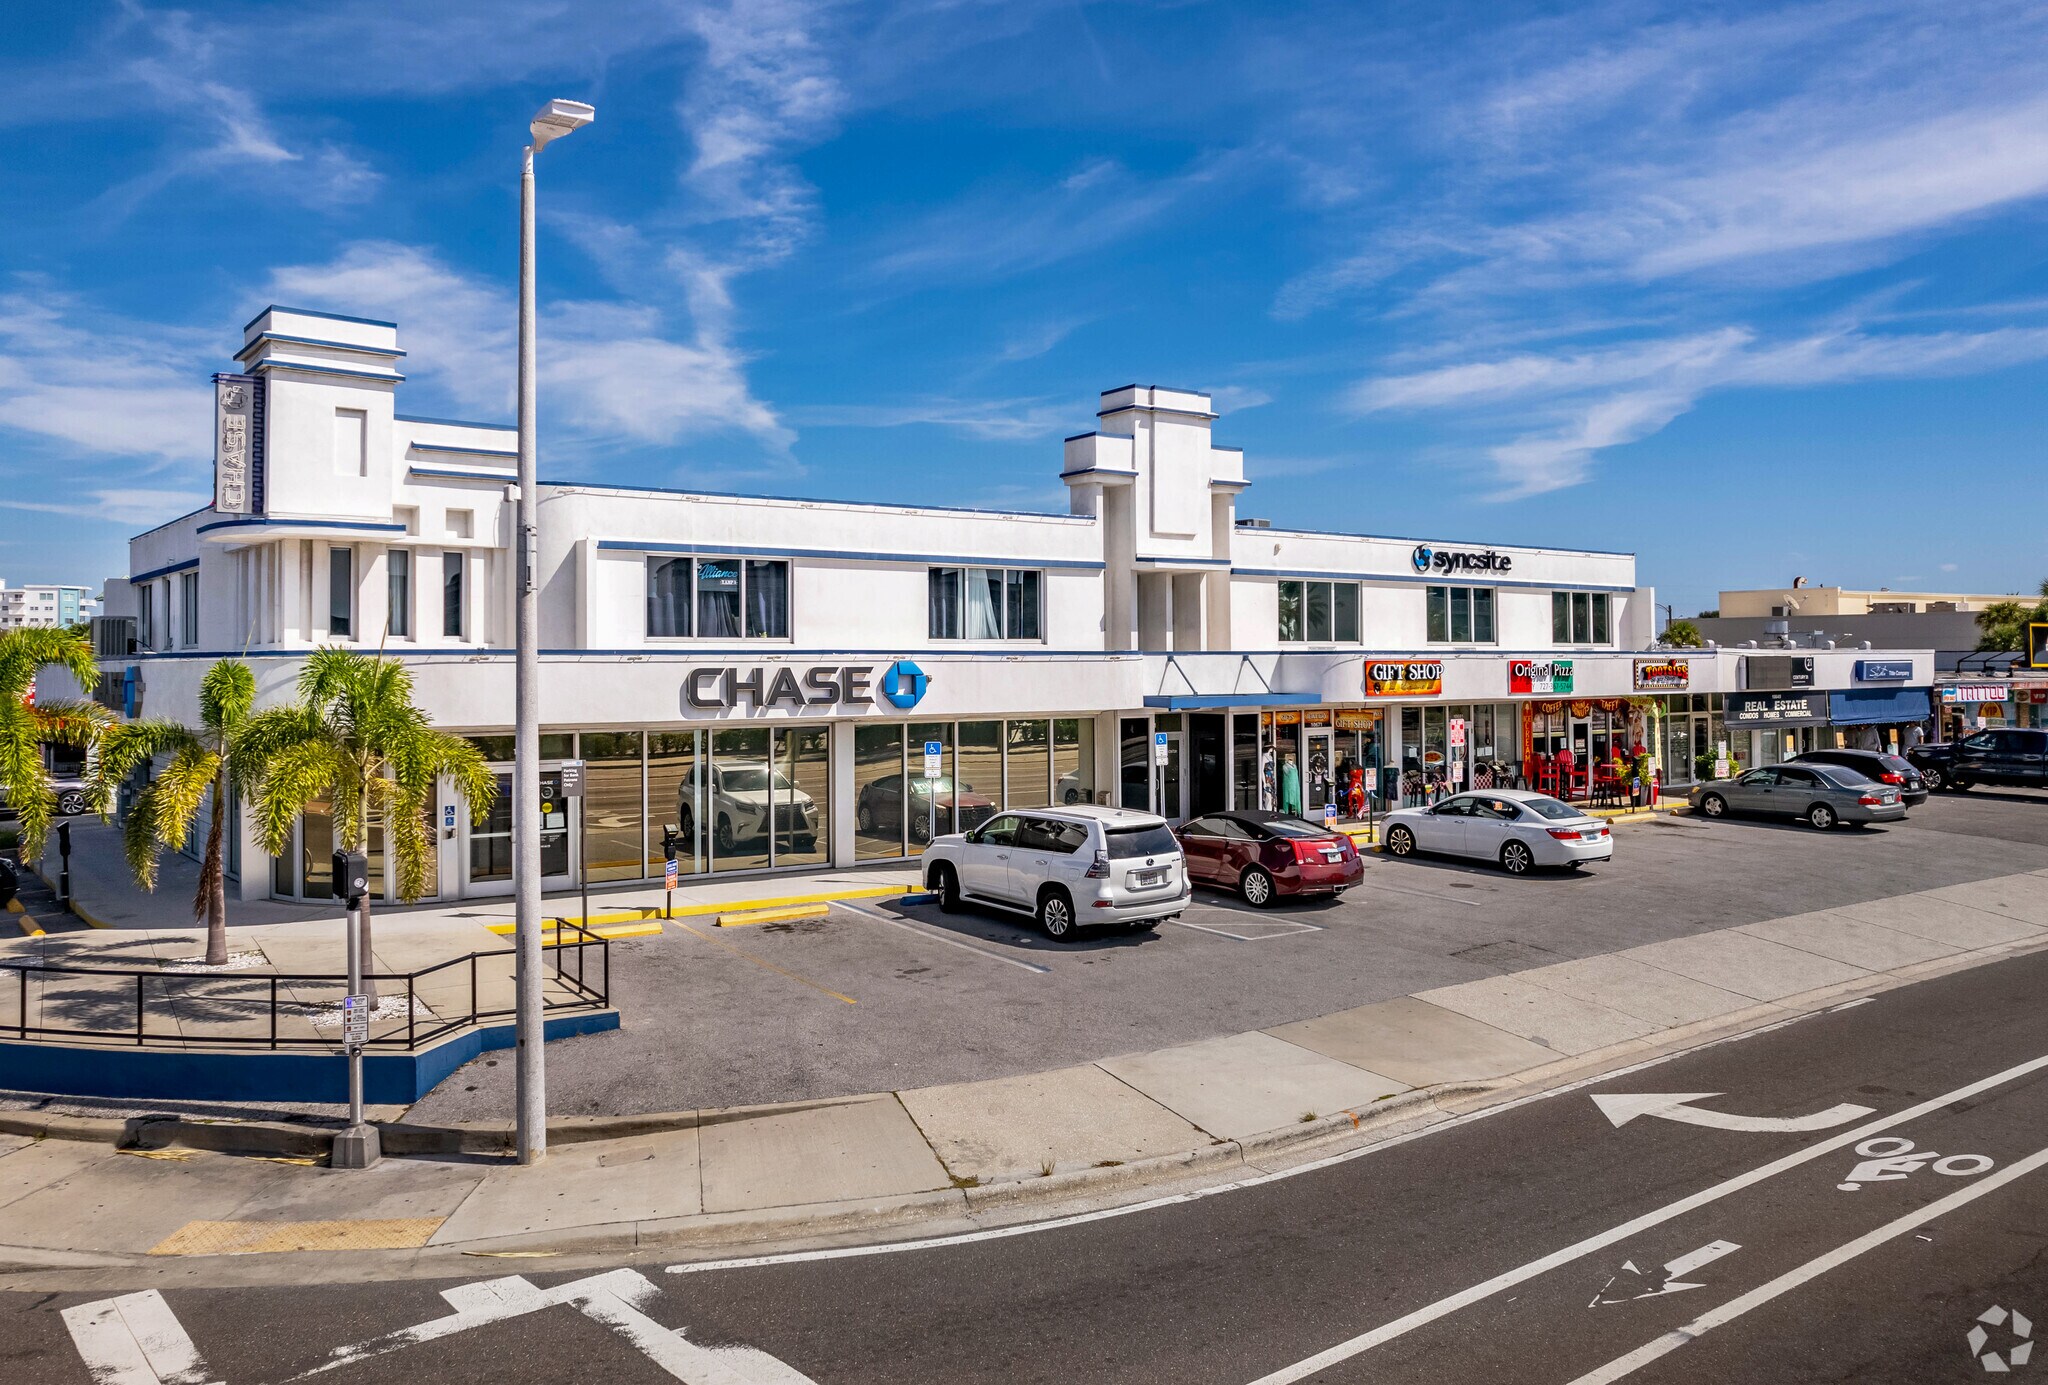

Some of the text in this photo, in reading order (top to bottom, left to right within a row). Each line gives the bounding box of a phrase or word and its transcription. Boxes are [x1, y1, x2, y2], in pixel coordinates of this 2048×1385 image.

[224, 414, 246, 506] CHASE
[1433, 550, 1512, 574] syncsite
[698, 563, 738, 580] Alliance
[1373, 663, 1445, 680] GIFT SHOP
[1515, 663, 1575, 678] Original Pizza
[686, 667, 876, 709] CHASE
[1958, 684, 2005, 701] TATTOO
[1541, 699, 1562, 713] COFFEE
[1600, 699, 1619, 711] TAFFY
[1744, 699, 1808, 712] REAL ESTATE
[1739, 712, 1759, 720] CONDOS
[1784, 710, 1813, 718] COMMERCIAL
[1335, 719, 1373, 729] GIFT SHOP
